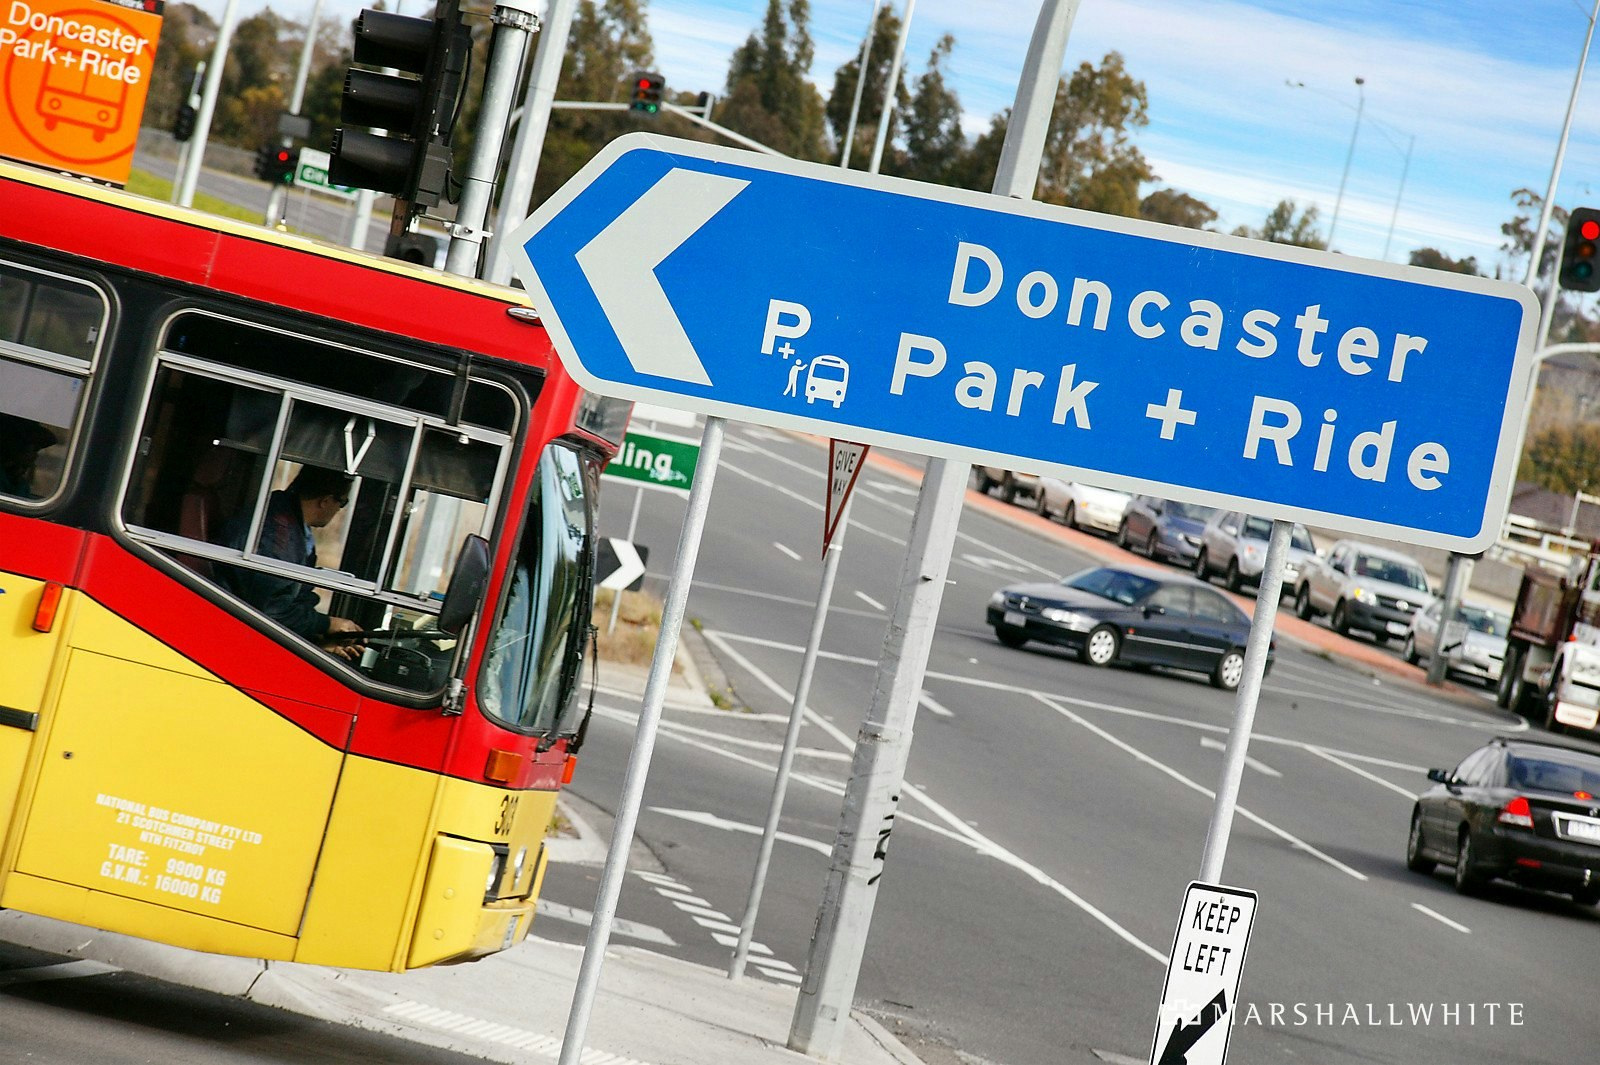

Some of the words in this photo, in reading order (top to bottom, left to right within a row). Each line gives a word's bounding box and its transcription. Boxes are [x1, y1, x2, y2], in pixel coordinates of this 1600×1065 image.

[8, 1, 149, 56] Doncaster
[948, 241, 1428, 383] Doncaster
[890, 332, 1100, 430] Park
[1145, 388, 1198, 441] +
[1243, 395, 1451, 491] Ride
[835, 450, 857, 473] GIVE
[832, 478, 848, 497] WAY
[95, 793, 147, 816] NATIONAL
[147, 806, 171, 822] BUS
[170, 812, 222, 834] COMPANY
[220, 825, 243, 840] PTY
[241, 831, 263, 845] LTD
[116, 811, 131, 825] 21
[131, 816, 196, 841] SCOTCHMER
[195, 832, 236, 851] STREET
[139, 831, 163, 846] NTH
[162, 836, 206, 856] FITZROY
[100, 861, 150, 887] G.V.M.:
[154, 874, 199, 899] 16000
[200, 886, 222, 905] KG
[108, 843, 150, 867] TARE:
[165, 858, 205, 880] 9900
[205, 867, 227, 887] KG
[1192, 900, 1241, 935] KEEP
[1183, 942, 1232, 976] LEFT
